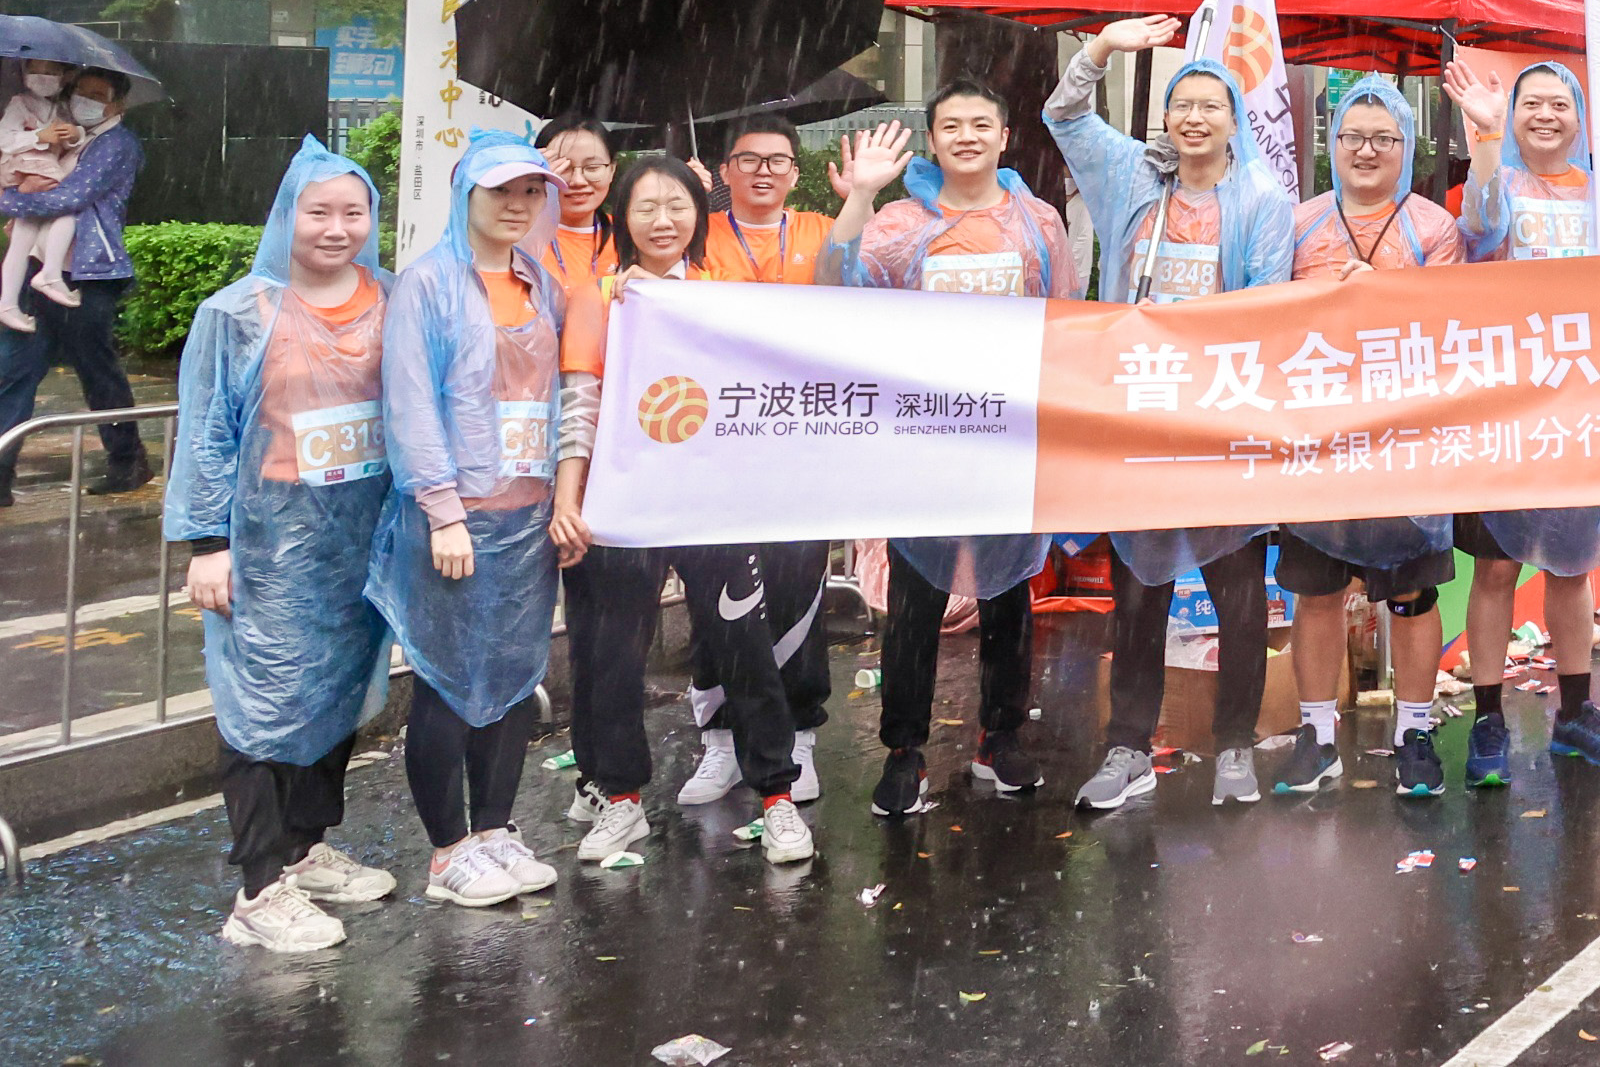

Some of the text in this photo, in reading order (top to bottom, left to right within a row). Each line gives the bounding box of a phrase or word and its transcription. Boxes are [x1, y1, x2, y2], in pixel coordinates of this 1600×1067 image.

[1516, 214, 1537, 244] C
[959, 269, 1021, 294] 3157
[1159, 260, 1216, 285] 3248
[718, 381, 880, 419] 宁波银行
[894, 392, 1007, 419] 深圳分行
[501, 421, 524, 456] C
[714, 421, 880, 437] BANK OF NINGBO
[893, 424, 1007, 435] SHENZHEN BRANCH
[302, 429, 333, 467] C
